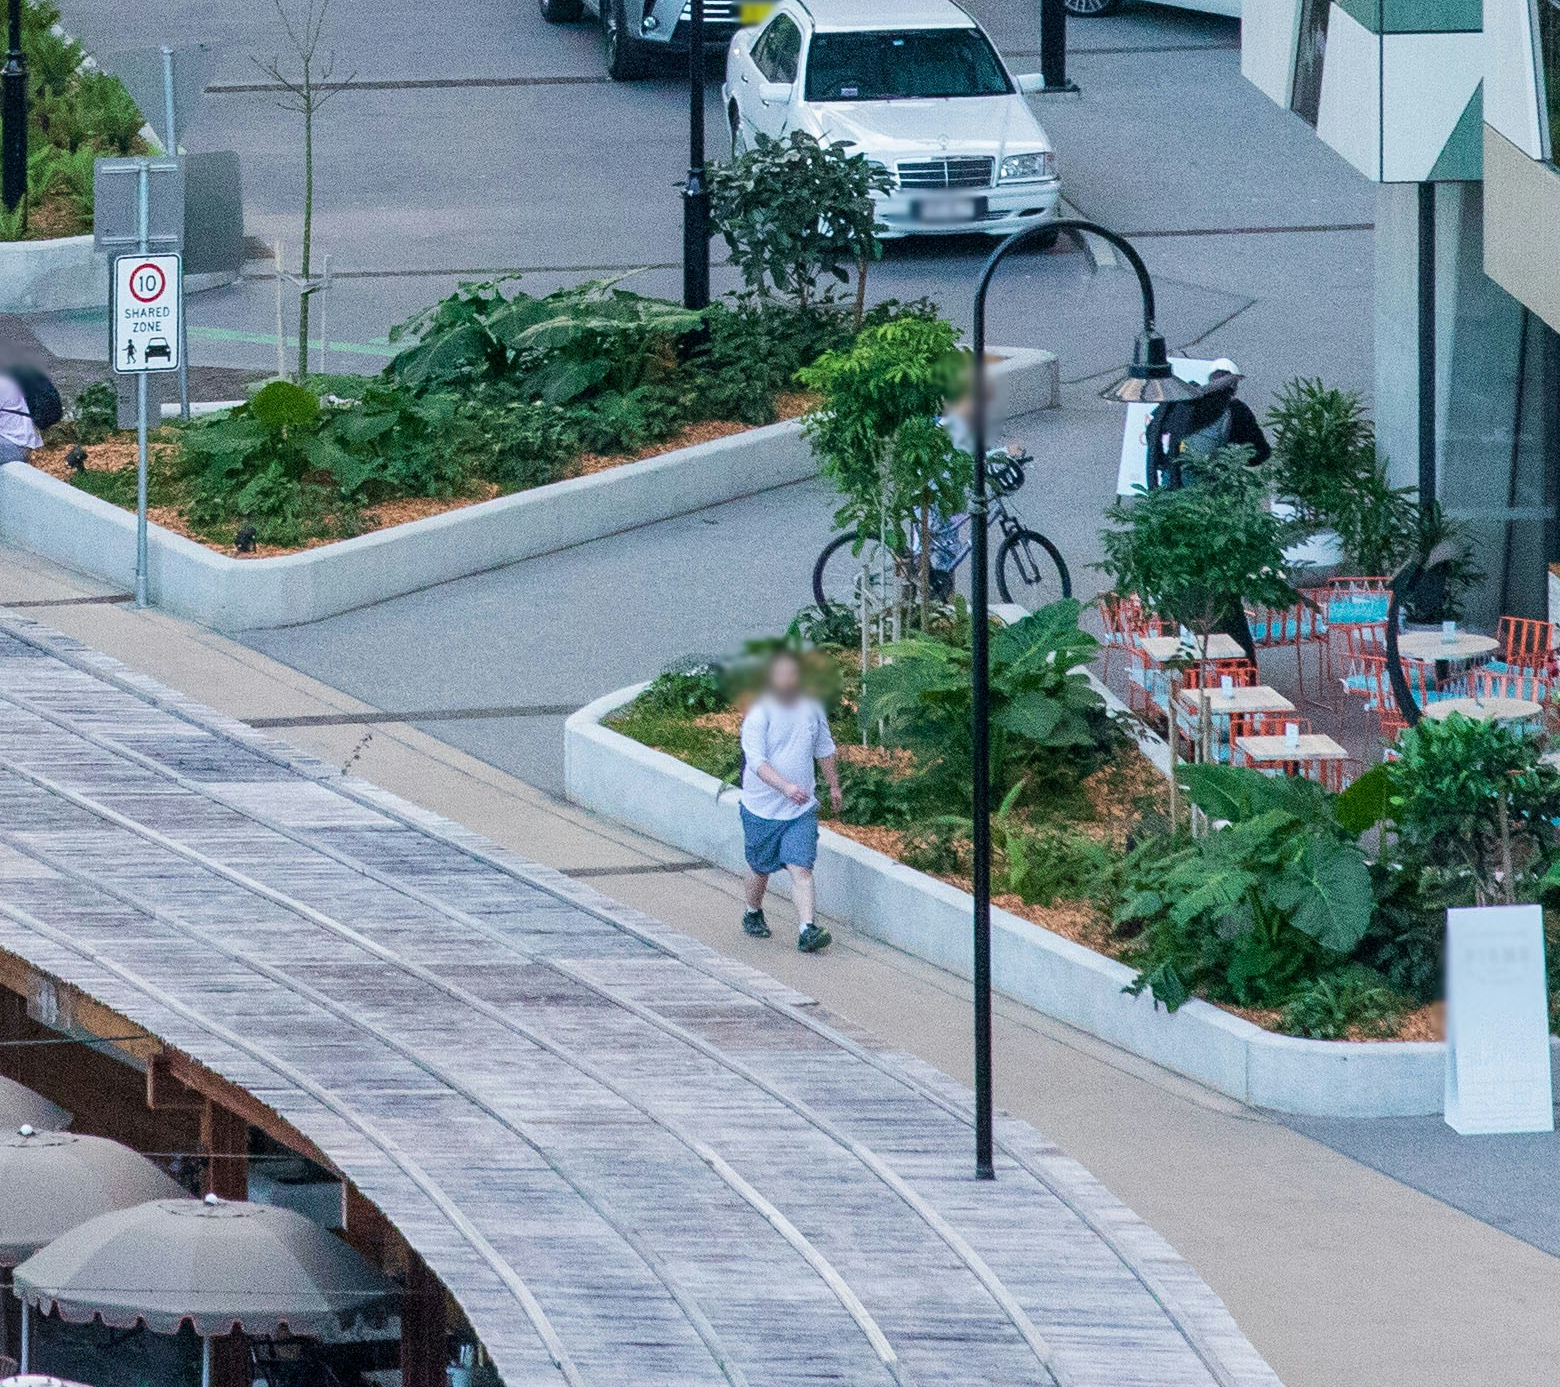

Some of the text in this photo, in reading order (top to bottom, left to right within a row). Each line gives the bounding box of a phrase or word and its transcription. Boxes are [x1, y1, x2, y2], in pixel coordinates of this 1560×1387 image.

[138, 275, 157, 292] 10
[124, 306, 170, 319] SHARED
[132, 321, 162, 333] ZONE
